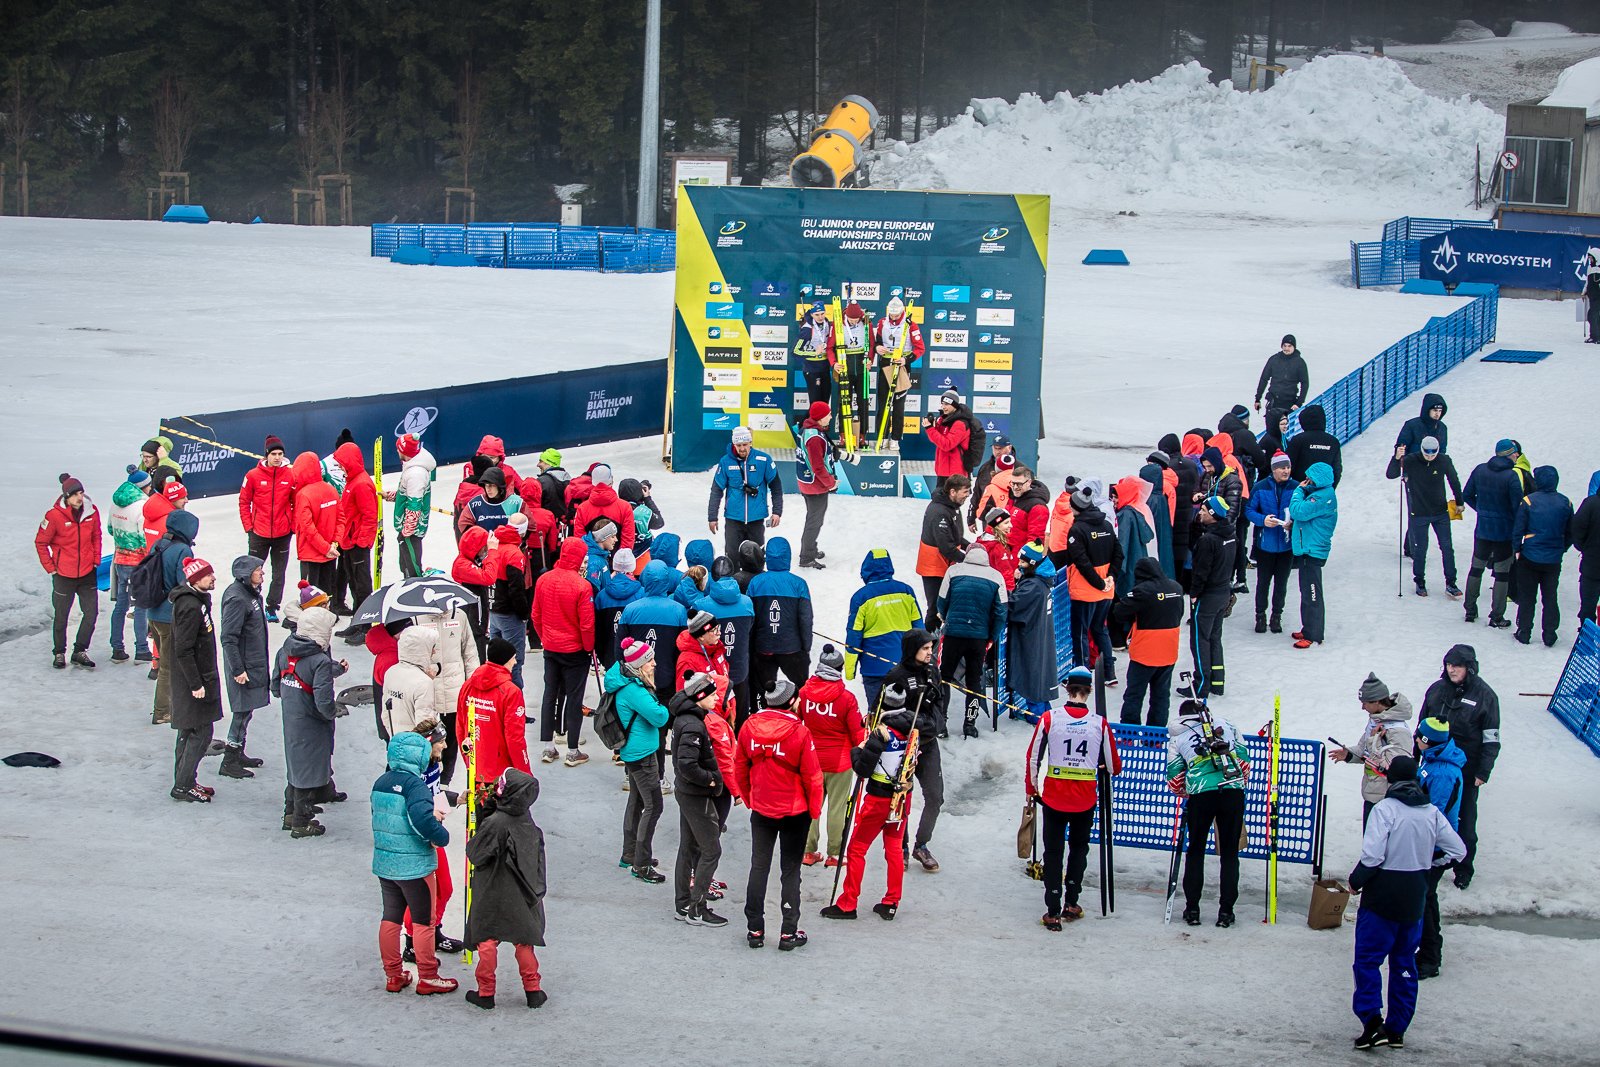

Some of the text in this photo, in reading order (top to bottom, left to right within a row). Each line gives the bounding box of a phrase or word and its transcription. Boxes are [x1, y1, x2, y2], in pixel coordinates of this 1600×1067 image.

[801, 219, 934, 230] IBU JUNIOR OPEN EUROPEAN
[803, 230, 932, 241] CHAMPIONSHIPS BIATHLON
[839, 241, 895, 250] JAKUSZYCE
[1467, 252, 1552, 268] KRYOSYSTEM
[590, 390, 606, 400] THE
[587, 396, 632, 410] BIATHLON
[586, 407, 620, 420] FAMILY
[182, 442, 202, 453] THE
[179, 449, 235, 464] BIATHLON
[914, 482, 922, 493] 3
[187, 561, 204, 576] SUI
[770, 600, 780, 633] AUT
[725, 622, 735, 656] AUT
[806, 699, 837, 717] POL
[1063, 739, 1088, 757] 14
